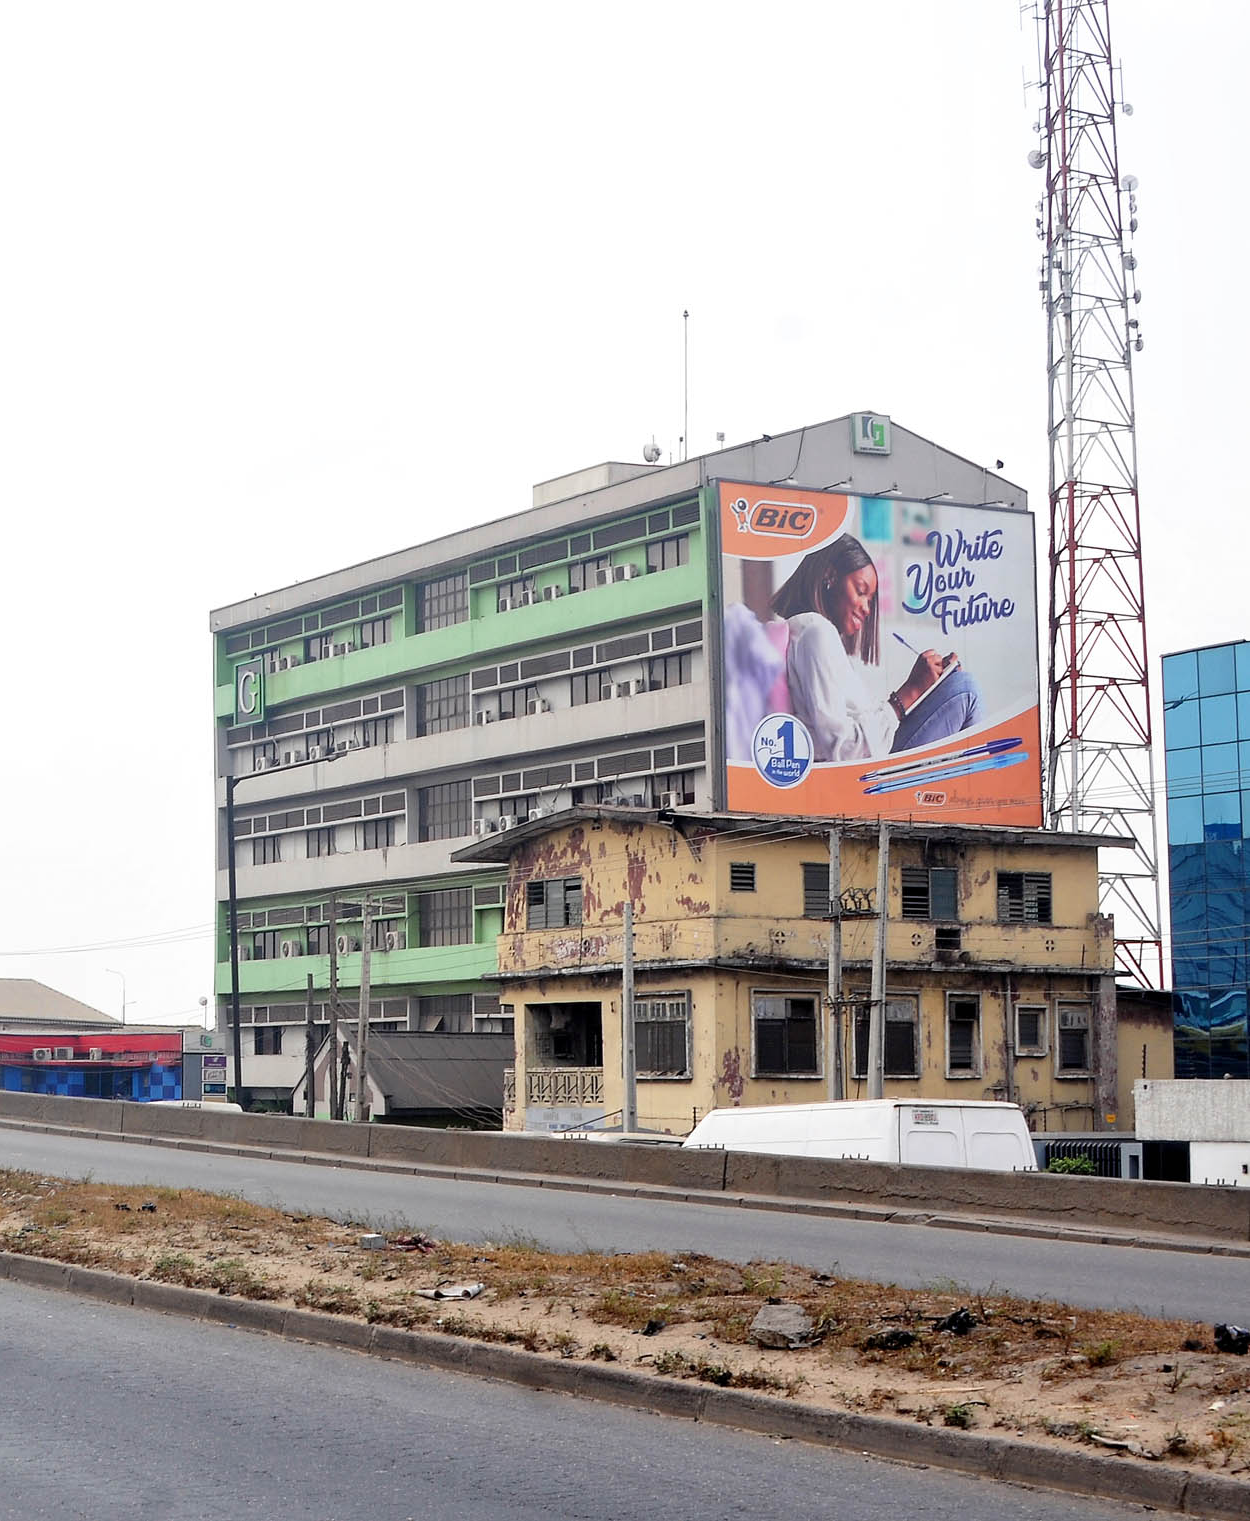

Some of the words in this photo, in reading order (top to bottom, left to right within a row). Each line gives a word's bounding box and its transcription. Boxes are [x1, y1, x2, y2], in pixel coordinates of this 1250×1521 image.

[926, 528, 1003, 568] Write
[902, 561, 975, 614] Your
[931, 592, 1015, 635] Future
[240, 671, 258, 713] G
[761, 737, 776, 746] No.
[777, 721, 794, 760] 1
[771, 759, 785, 768] Ball
[786, 760, 800, 768] Pen
